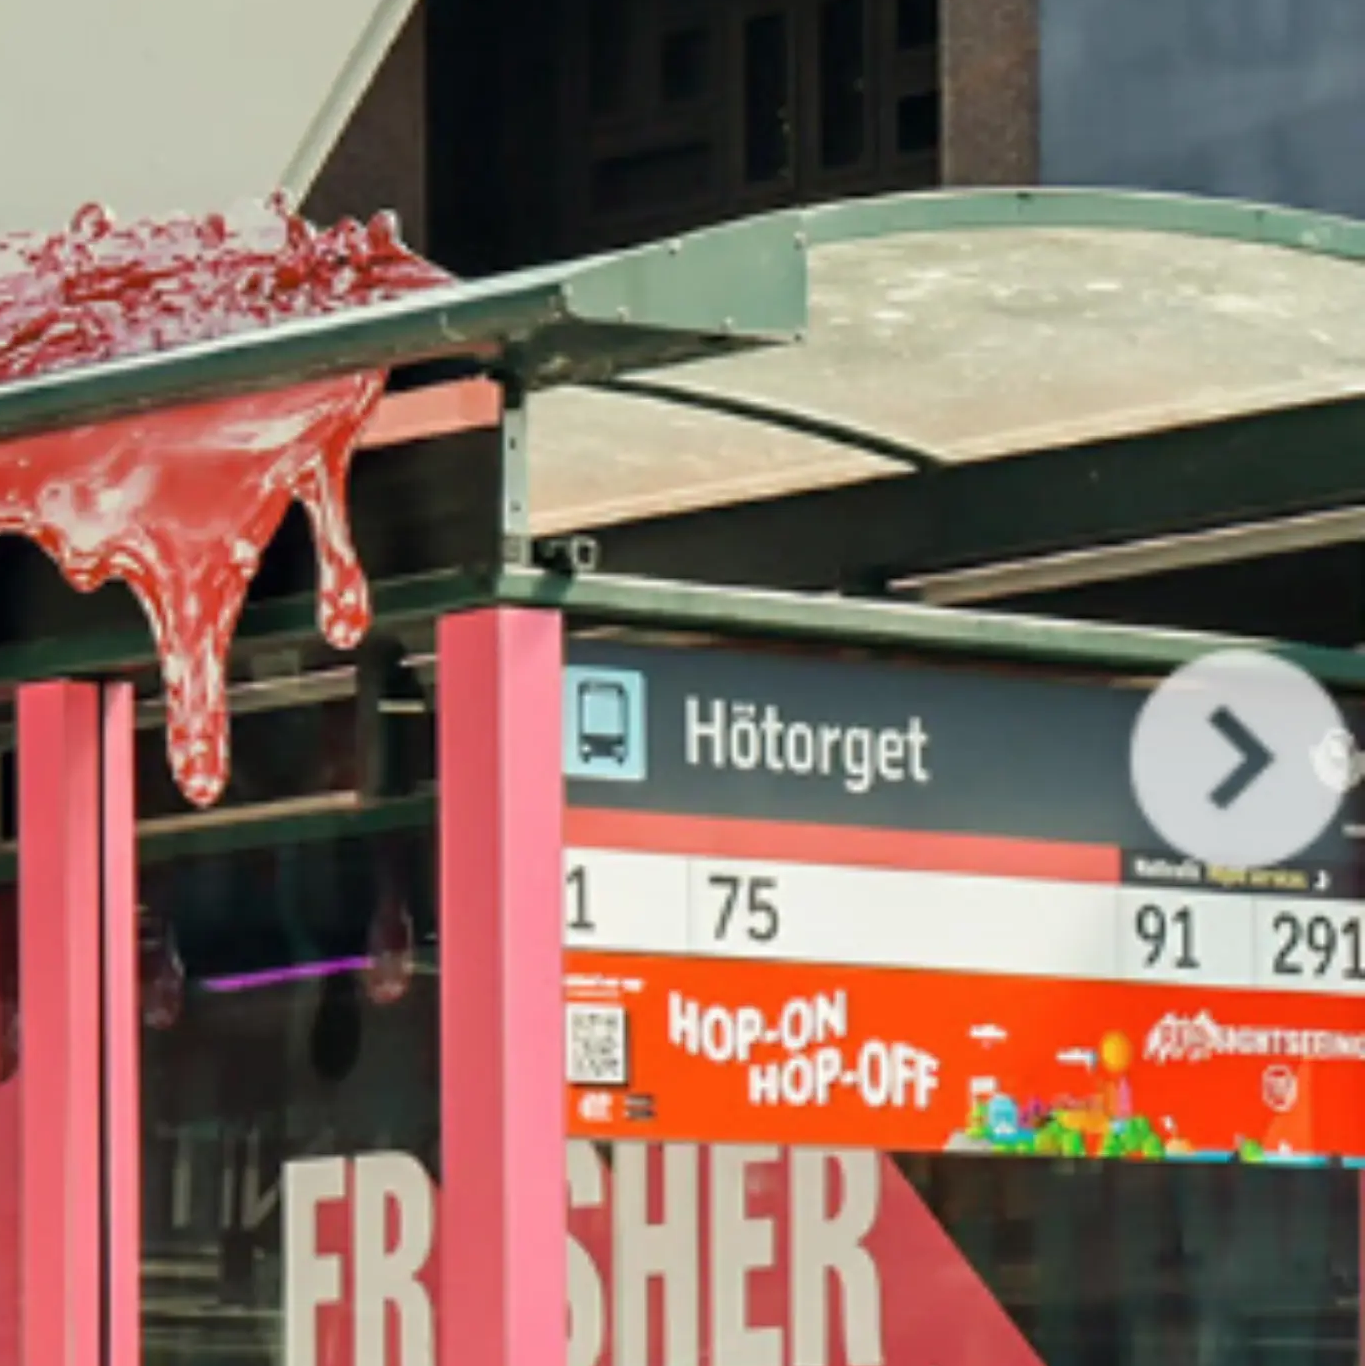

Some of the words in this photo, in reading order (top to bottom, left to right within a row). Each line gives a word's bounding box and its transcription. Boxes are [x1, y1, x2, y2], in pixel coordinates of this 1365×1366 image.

[684, 694, 930, 793] Hötorget
[708, 874, 780, 942] 75
[1134, 902, 1200, 969] 91
[1271, 910, 1365, 980] 291
[668, 988, 849, 1064] HOP-ON
[748, 1036, 940, 1111] HOP-OFF
